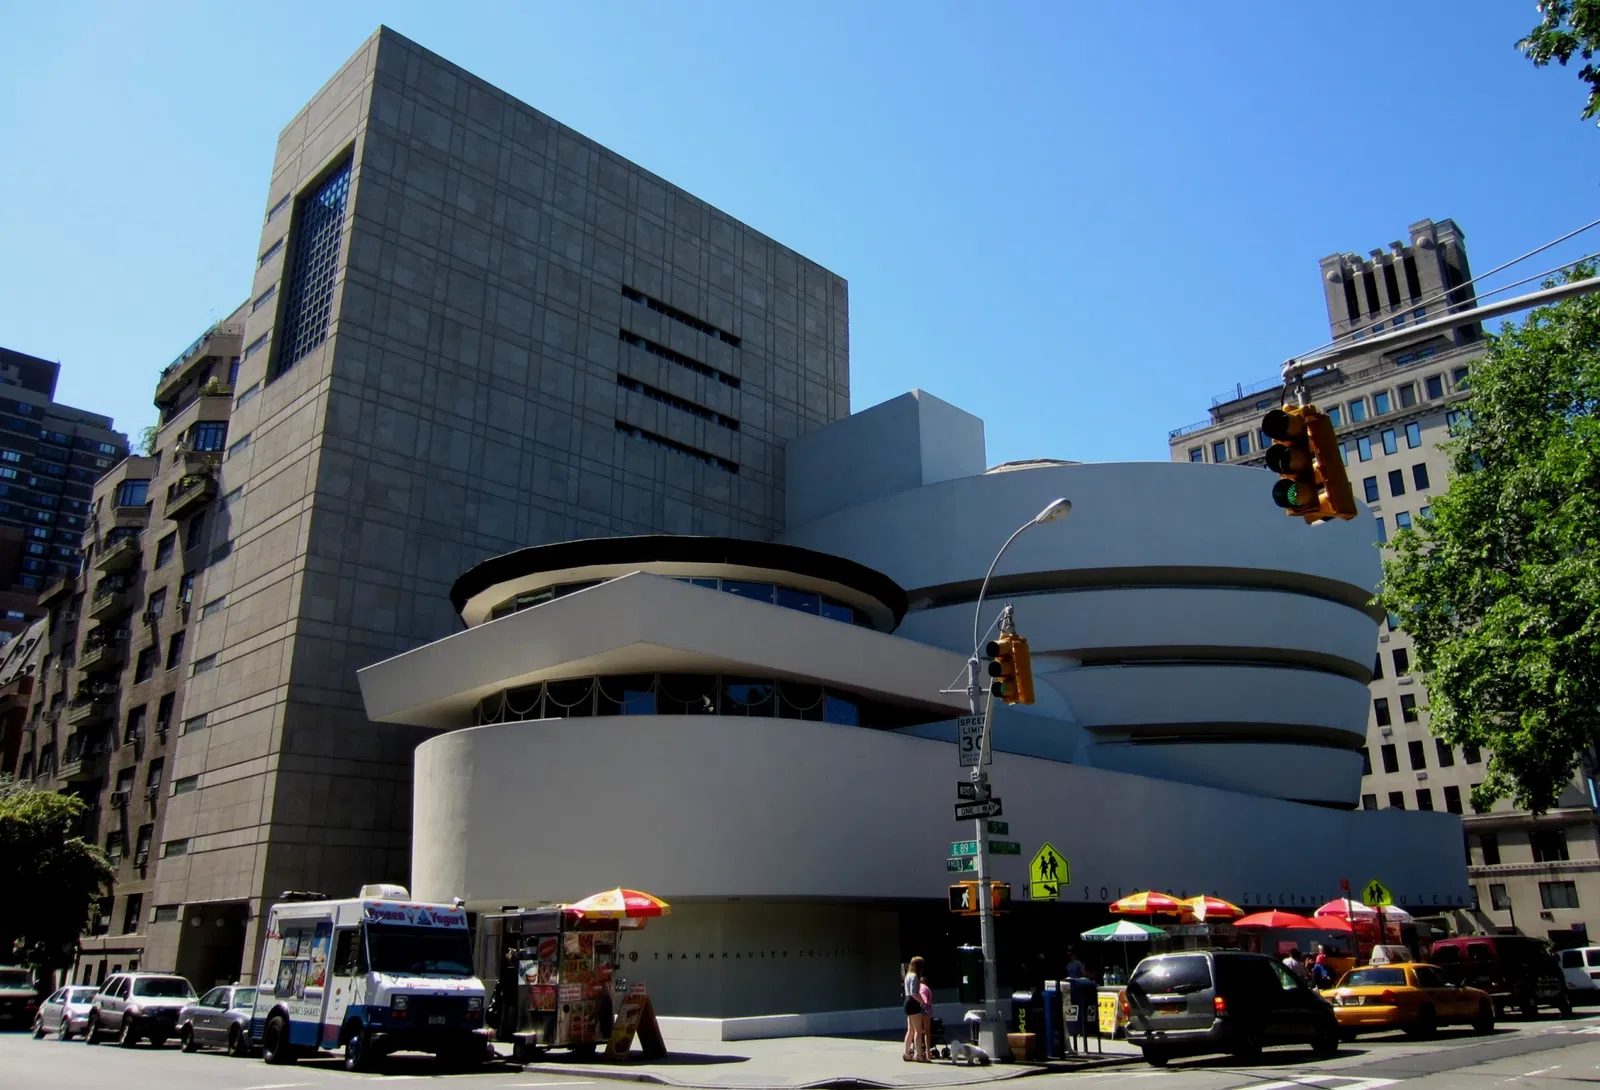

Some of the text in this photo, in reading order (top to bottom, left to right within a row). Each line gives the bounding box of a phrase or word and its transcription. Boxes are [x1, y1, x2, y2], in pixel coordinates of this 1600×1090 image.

[961, 803, 996, 816] ONE WAY
[953, 844, 959, 854] E
[960, 843, 969, 853] 89
[1400, 894, 1465, 905] USEUM
[429, 911, 465, 927] Yogurt
